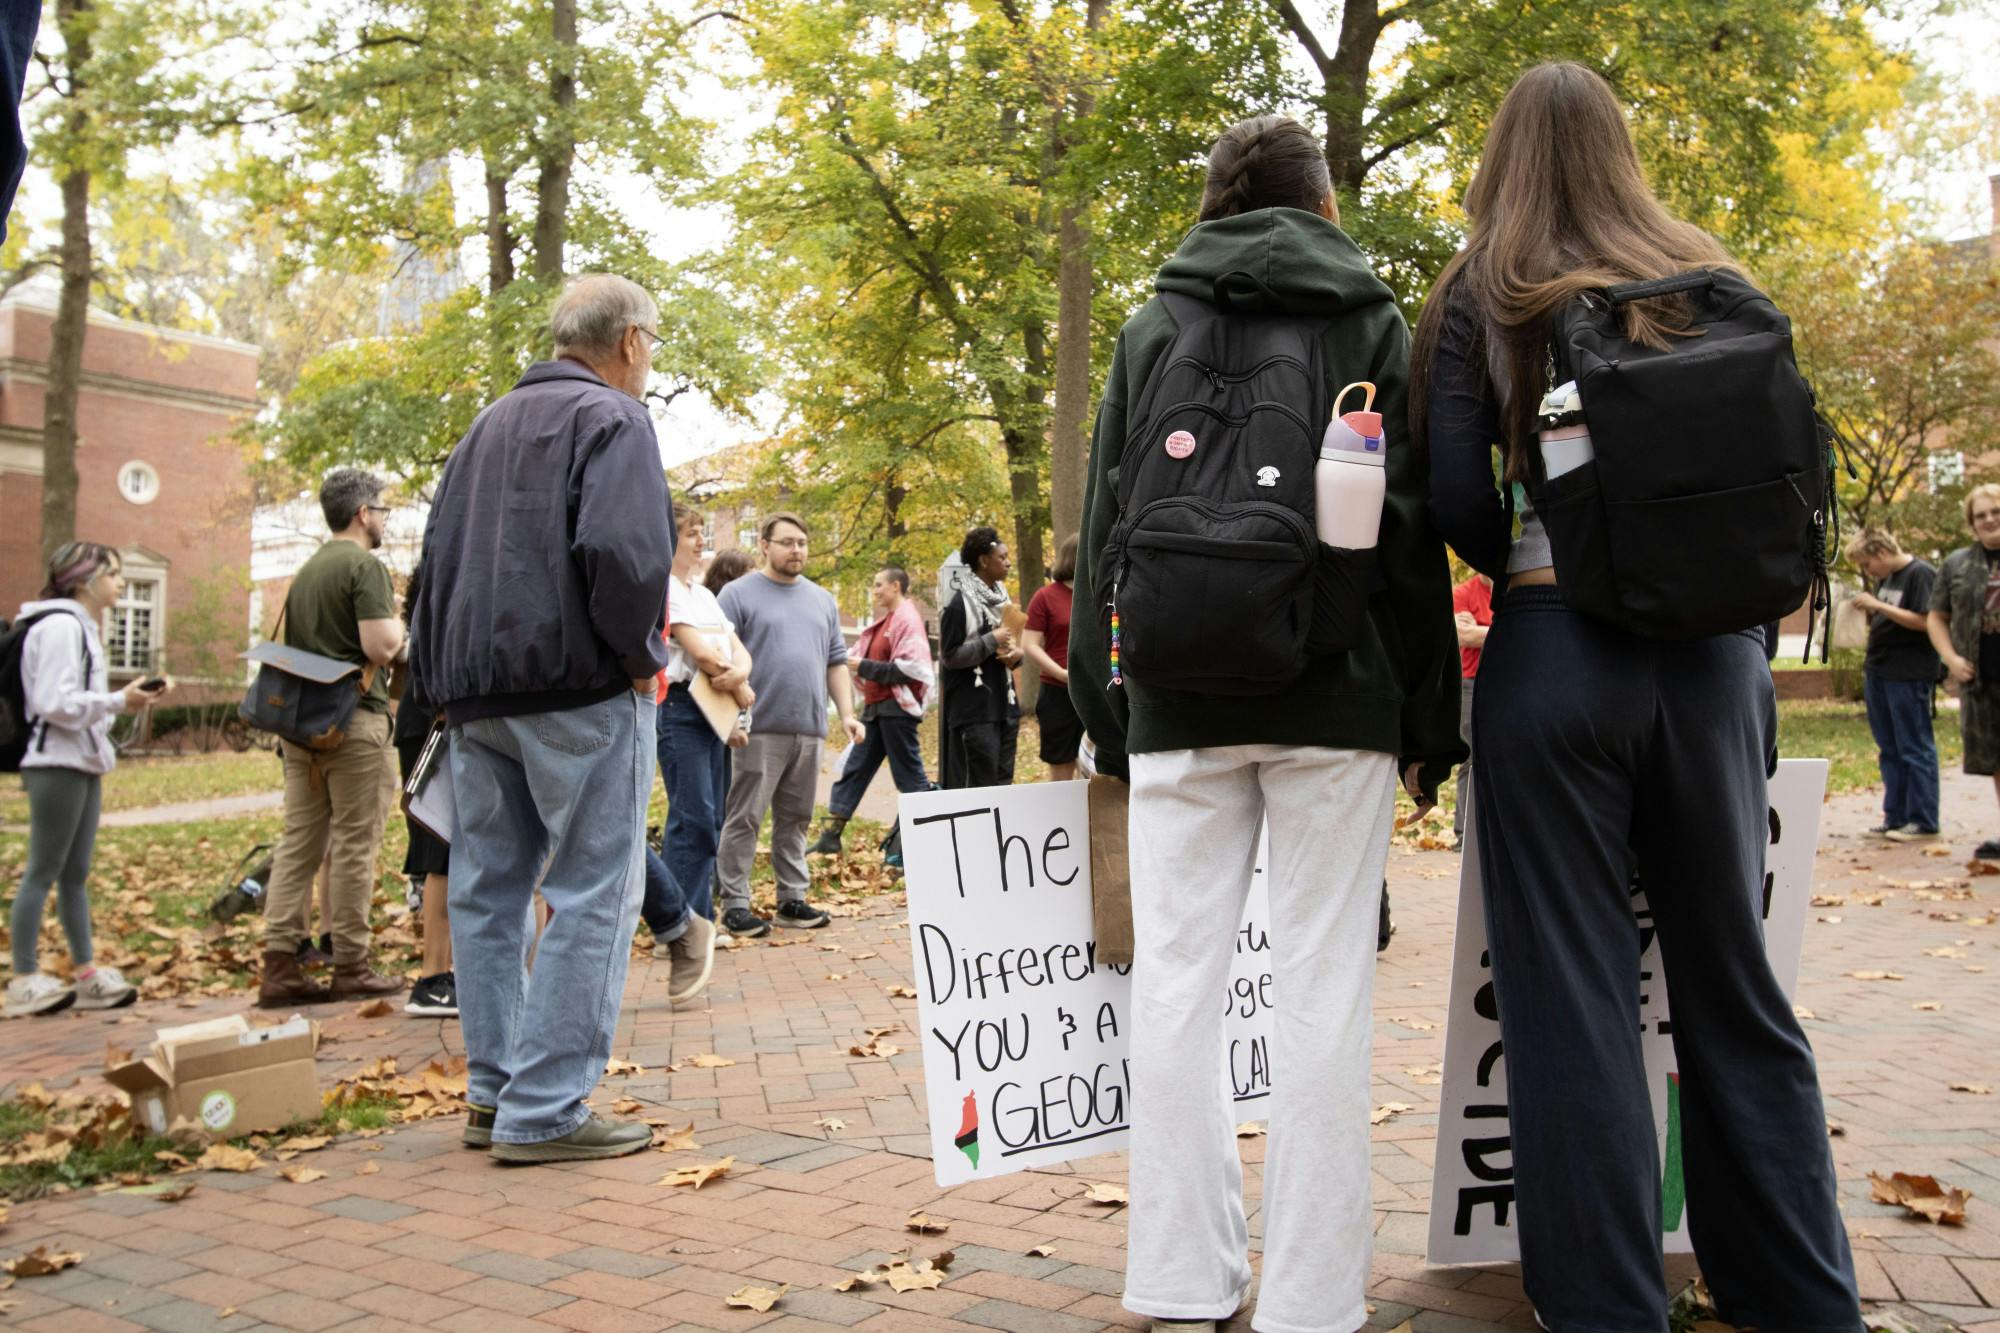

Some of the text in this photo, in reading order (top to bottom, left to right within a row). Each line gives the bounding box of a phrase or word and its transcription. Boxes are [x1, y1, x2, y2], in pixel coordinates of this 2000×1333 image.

[913, 807, 1080, 898] The
[931, 1001, 1119, 1081] YOU & A
